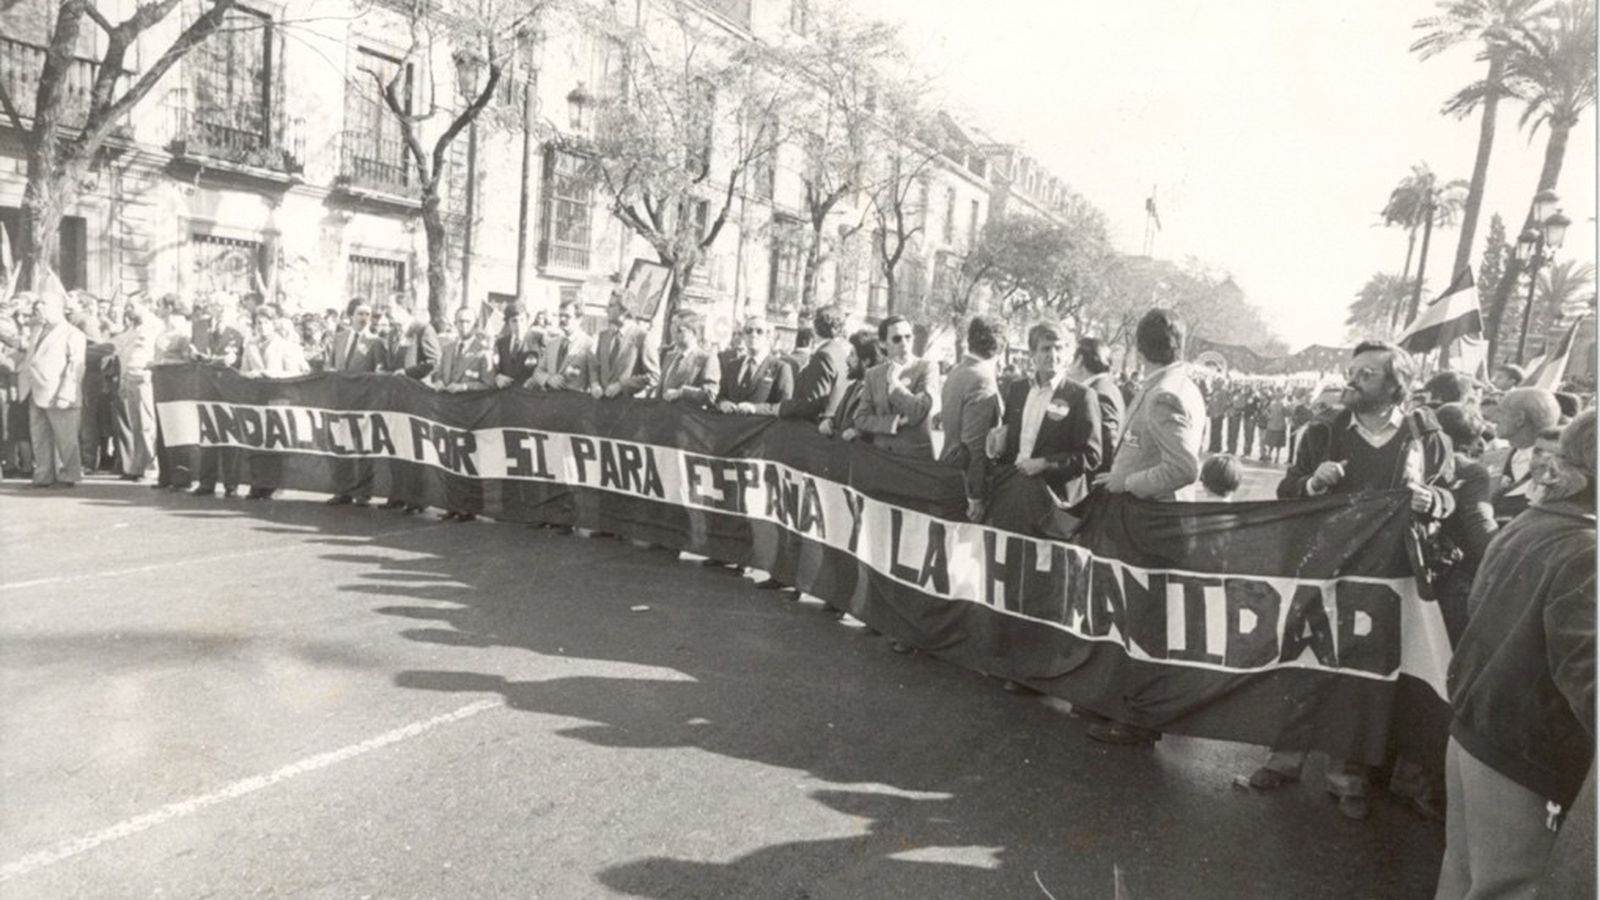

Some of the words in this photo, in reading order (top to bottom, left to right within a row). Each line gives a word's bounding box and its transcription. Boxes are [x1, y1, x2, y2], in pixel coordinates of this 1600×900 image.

[197, 403, 396, 455] ANDALUCIA
[410, 416, 479, 476] POR
[502, 429, 556, 480] SI
[570, 436, 666, 499] PARA
[684, 453, 826, 539] ESPAÑA
[843, 487, 865, 553] Y
[889, 508, 950, 594] LA
[984, 530, 1402, 677] HUMANIDAD
